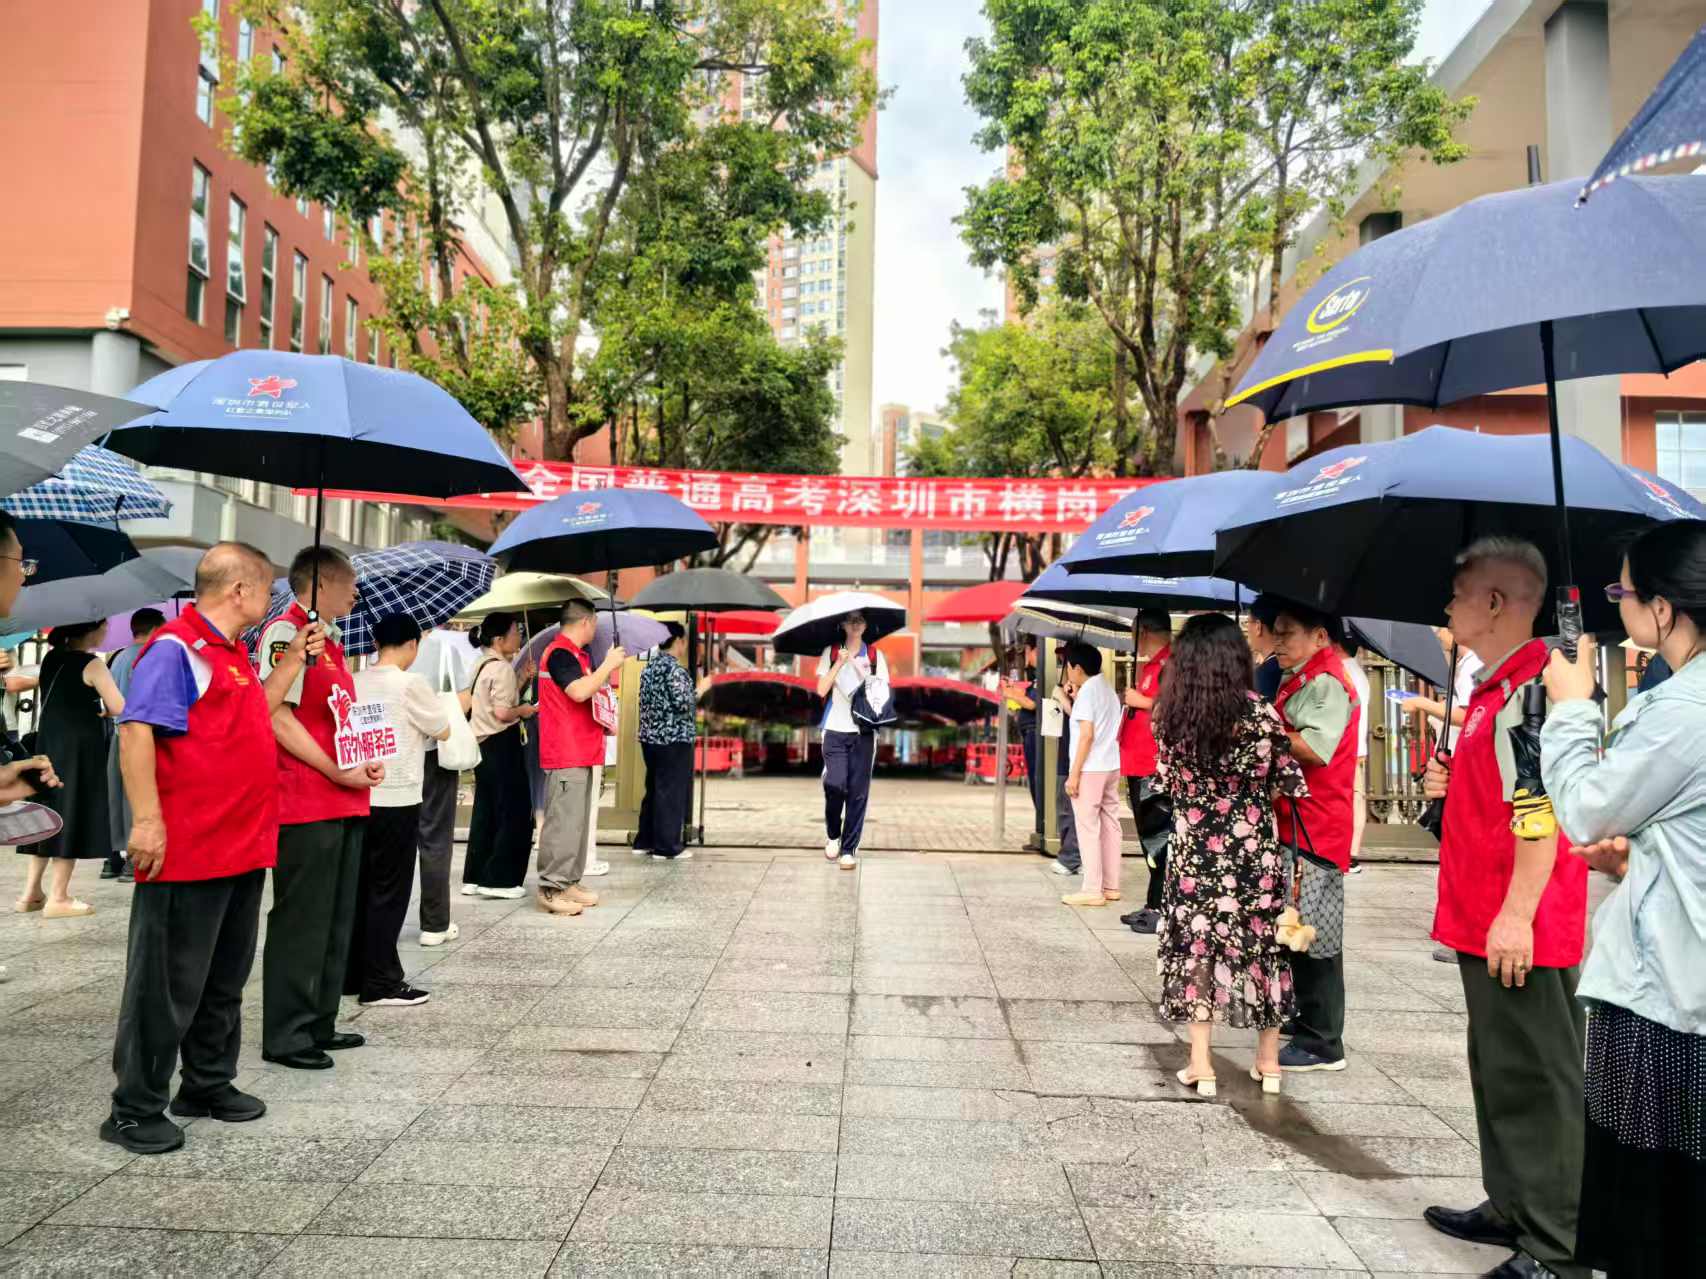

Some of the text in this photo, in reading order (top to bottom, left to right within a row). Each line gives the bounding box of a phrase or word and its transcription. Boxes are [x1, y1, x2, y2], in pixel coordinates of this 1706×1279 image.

[480, 462, 1137, 521] 全国普通高考深圳市横岗
[337, 726, 398, 765] 校外服务点
